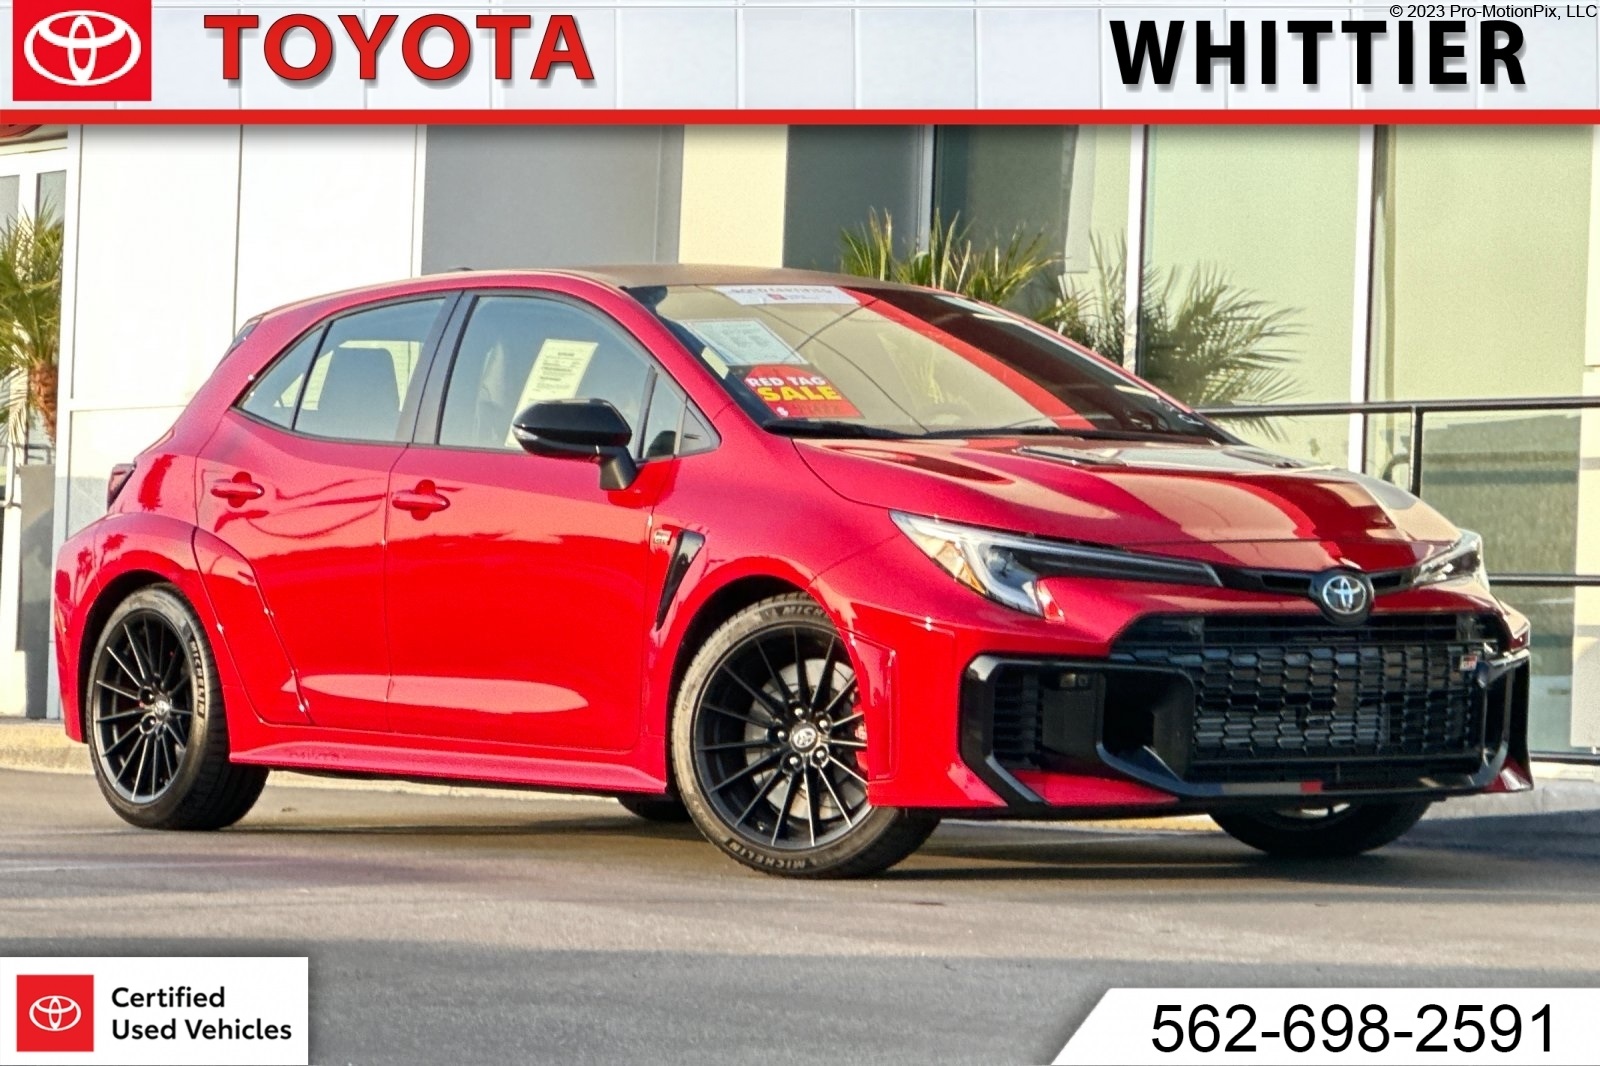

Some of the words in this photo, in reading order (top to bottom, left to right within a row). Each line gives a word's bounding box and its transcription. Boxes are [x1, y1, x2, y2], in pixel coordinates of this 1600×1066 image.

[745, 377, 784, 387] RED
[786, 376, 826, 386] TAG
[757, 385, 842, 402] SALE
[189, 640, 205, 713] MICHELIN
[728, 841, 806, 869] MICHELIN
